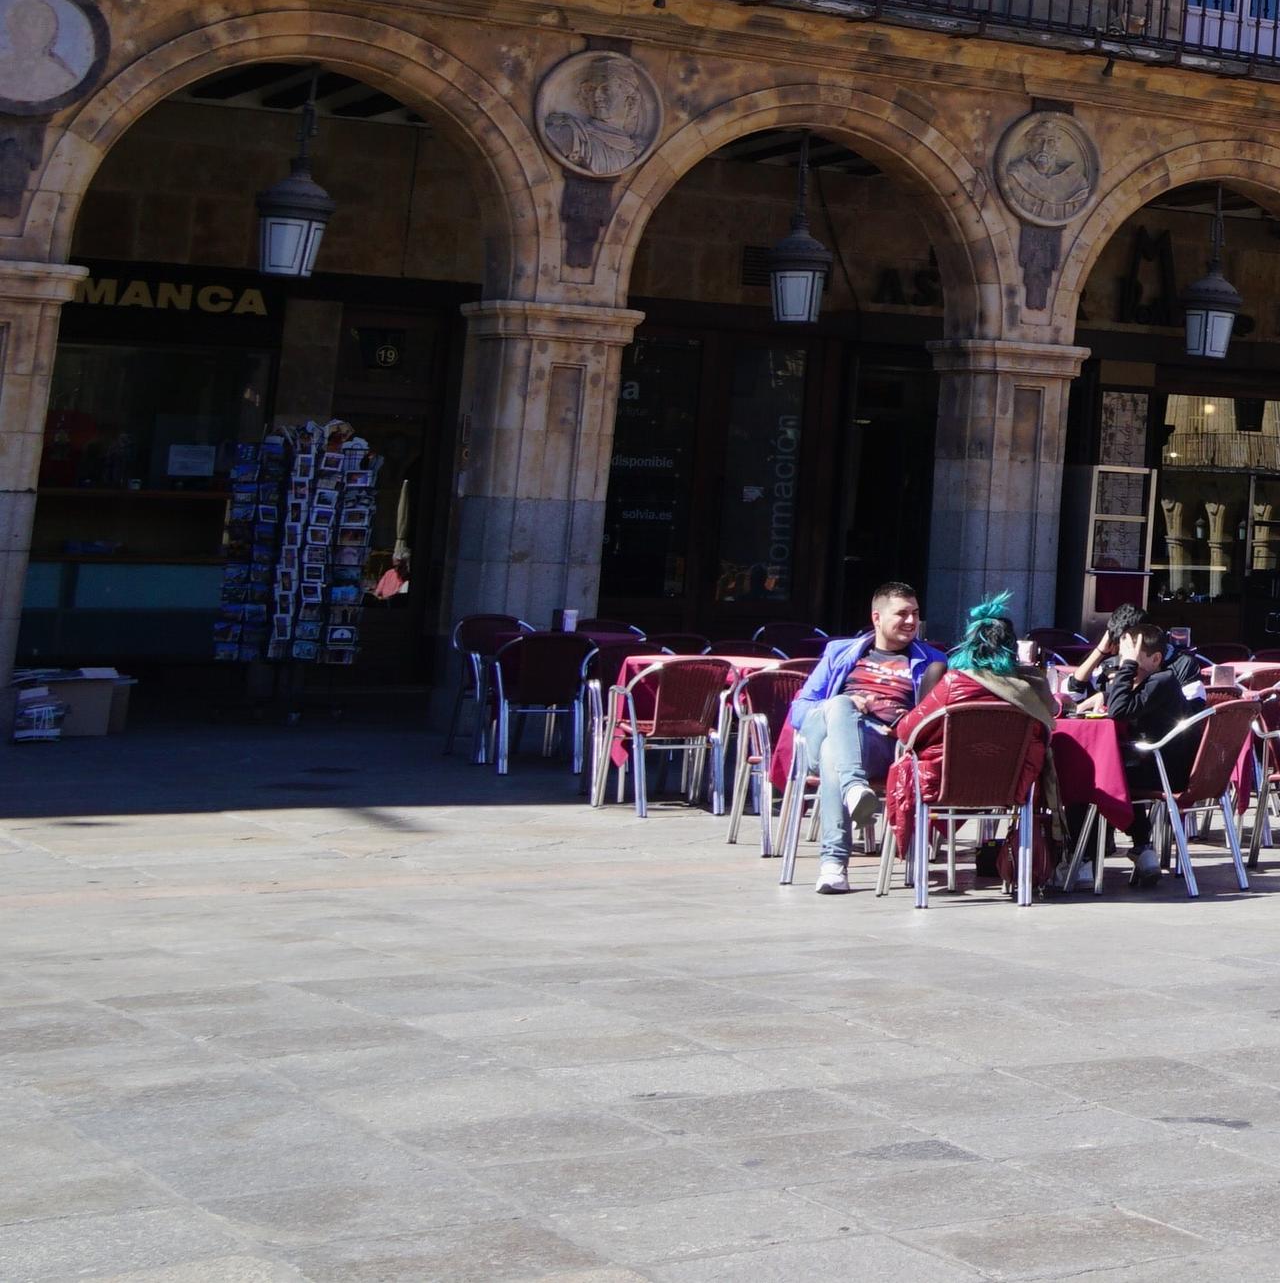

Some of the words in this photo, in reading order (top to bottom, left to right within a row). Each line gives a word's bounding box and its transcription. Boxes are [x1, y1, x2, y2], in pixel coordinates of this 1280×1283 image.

[75, 278, 268, 317] MANCA
[378, 349, 395, 363] 19
[612, 453, 673, 469] disponible
[622, 508, 672, 521] solvia.es
